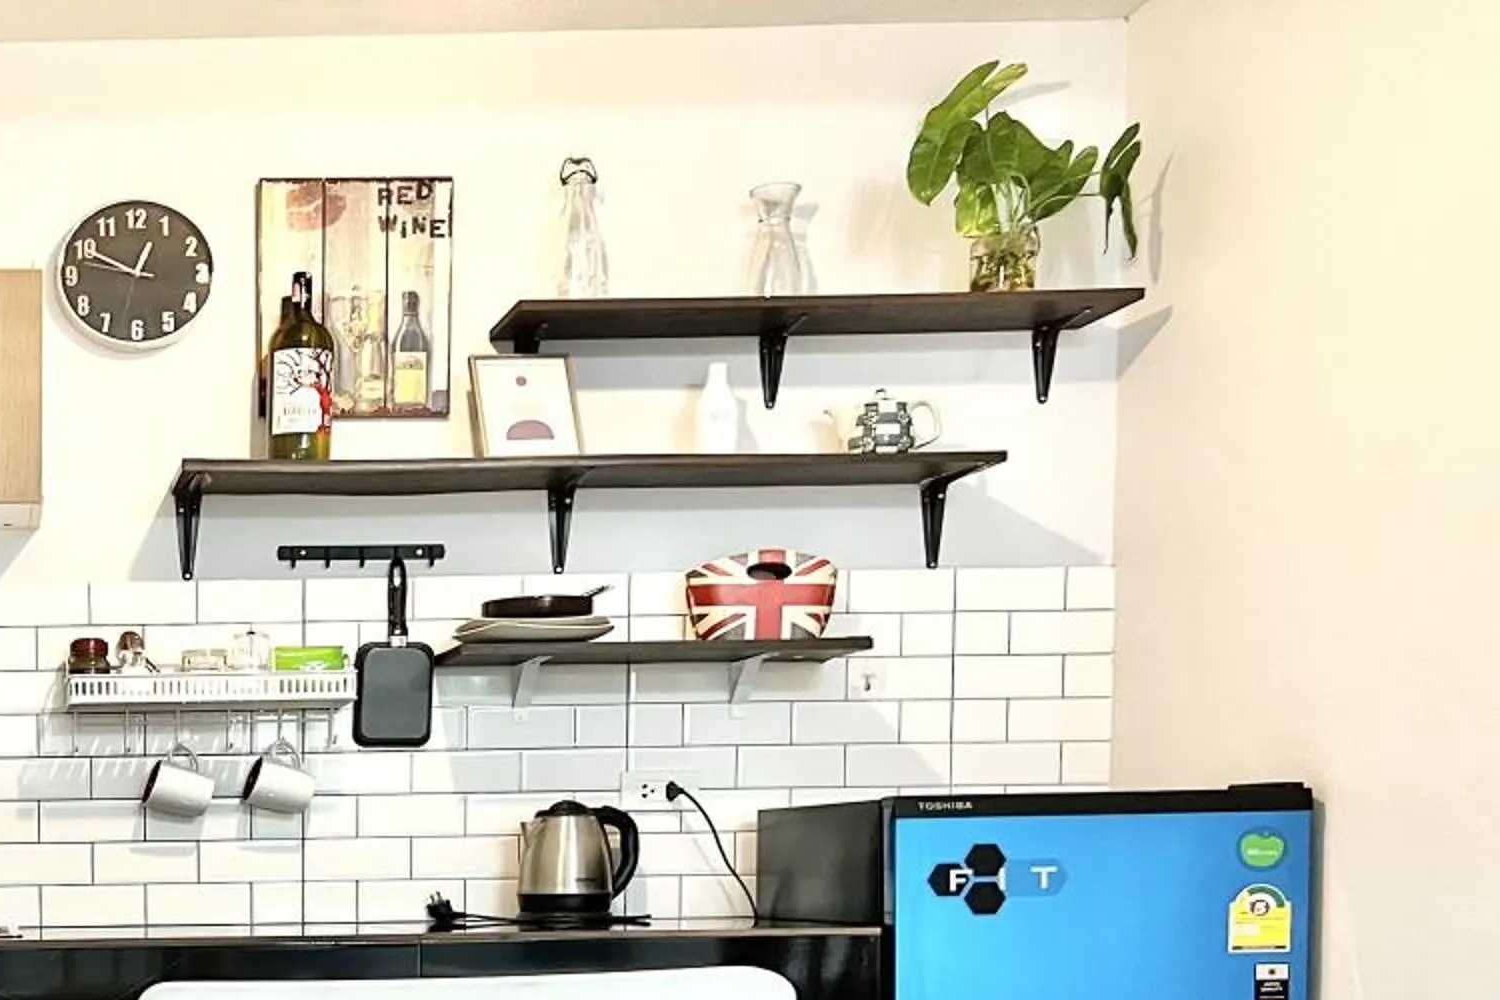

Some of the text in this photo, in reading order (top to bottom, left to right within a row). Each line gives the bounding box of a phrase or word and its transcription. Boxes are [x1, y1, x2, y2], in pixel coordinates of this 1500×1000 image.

[378, 180, 433, 206] RED
[98, 216, 116, 236] 11
[125, 208, 147, 229] 12
[160, 215, 169, 236] 1
[74, 238, 97, 259] 10
[185, 235, 198, 256] 2
[65, 265, 79, 286] 9
[195, 262, 209, 284] 3
[77, 295, 90, 316] 8
[183, 291, 197, 313] 4
[100, 312, 111, 332] 7
[131, 320, 145, 340] 6
[162, 311, 175, 332] 5
[918, 801, 973, 810] TOSHIBA
